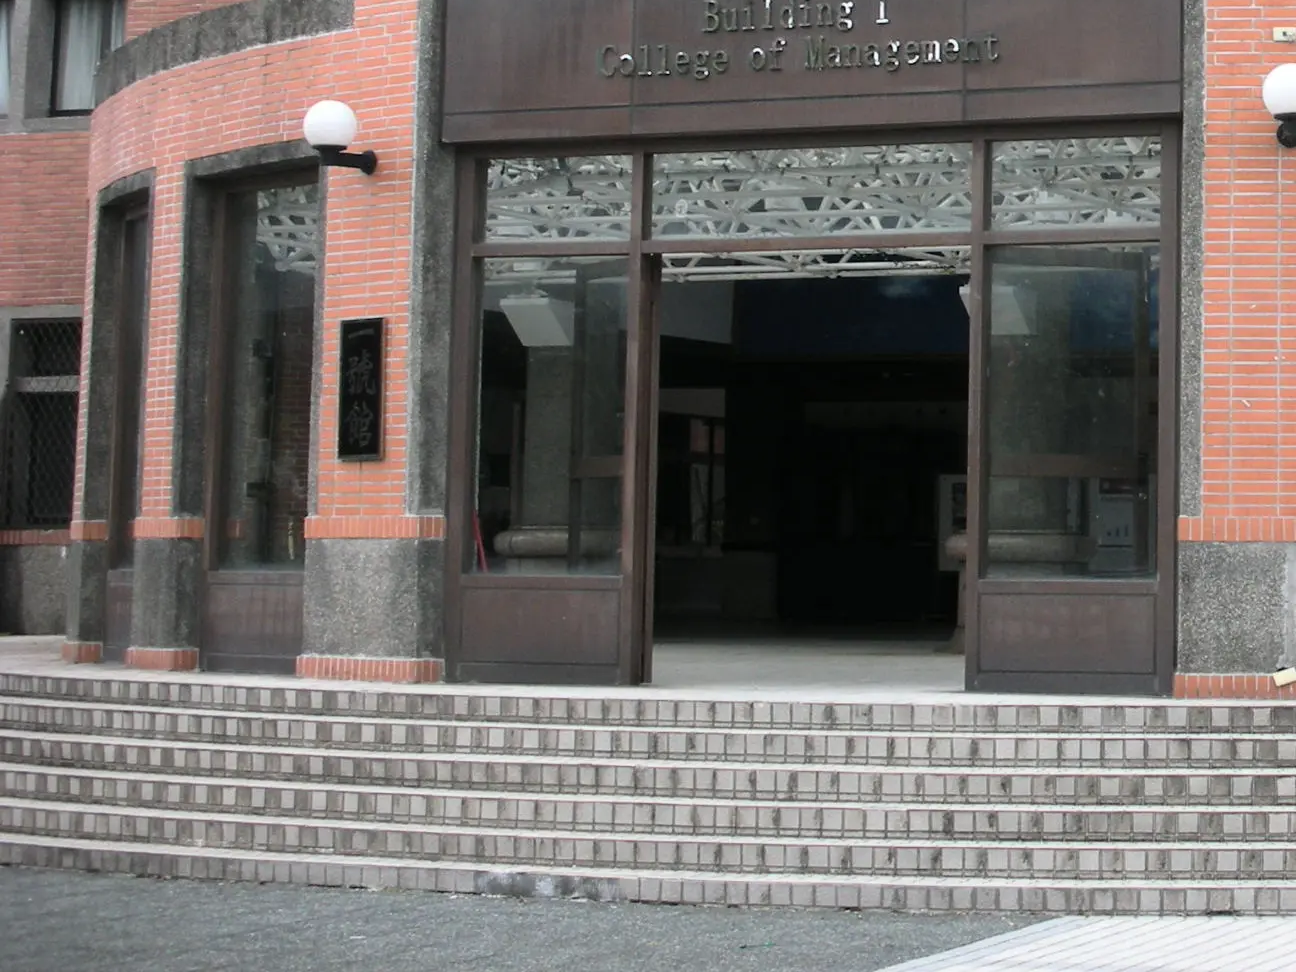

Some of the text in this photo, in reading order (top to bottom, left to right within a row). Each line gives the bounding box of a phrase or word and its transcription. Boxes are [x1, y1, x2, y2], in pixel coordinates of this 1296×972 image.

[600, 33, 1001, 80] College of Management
